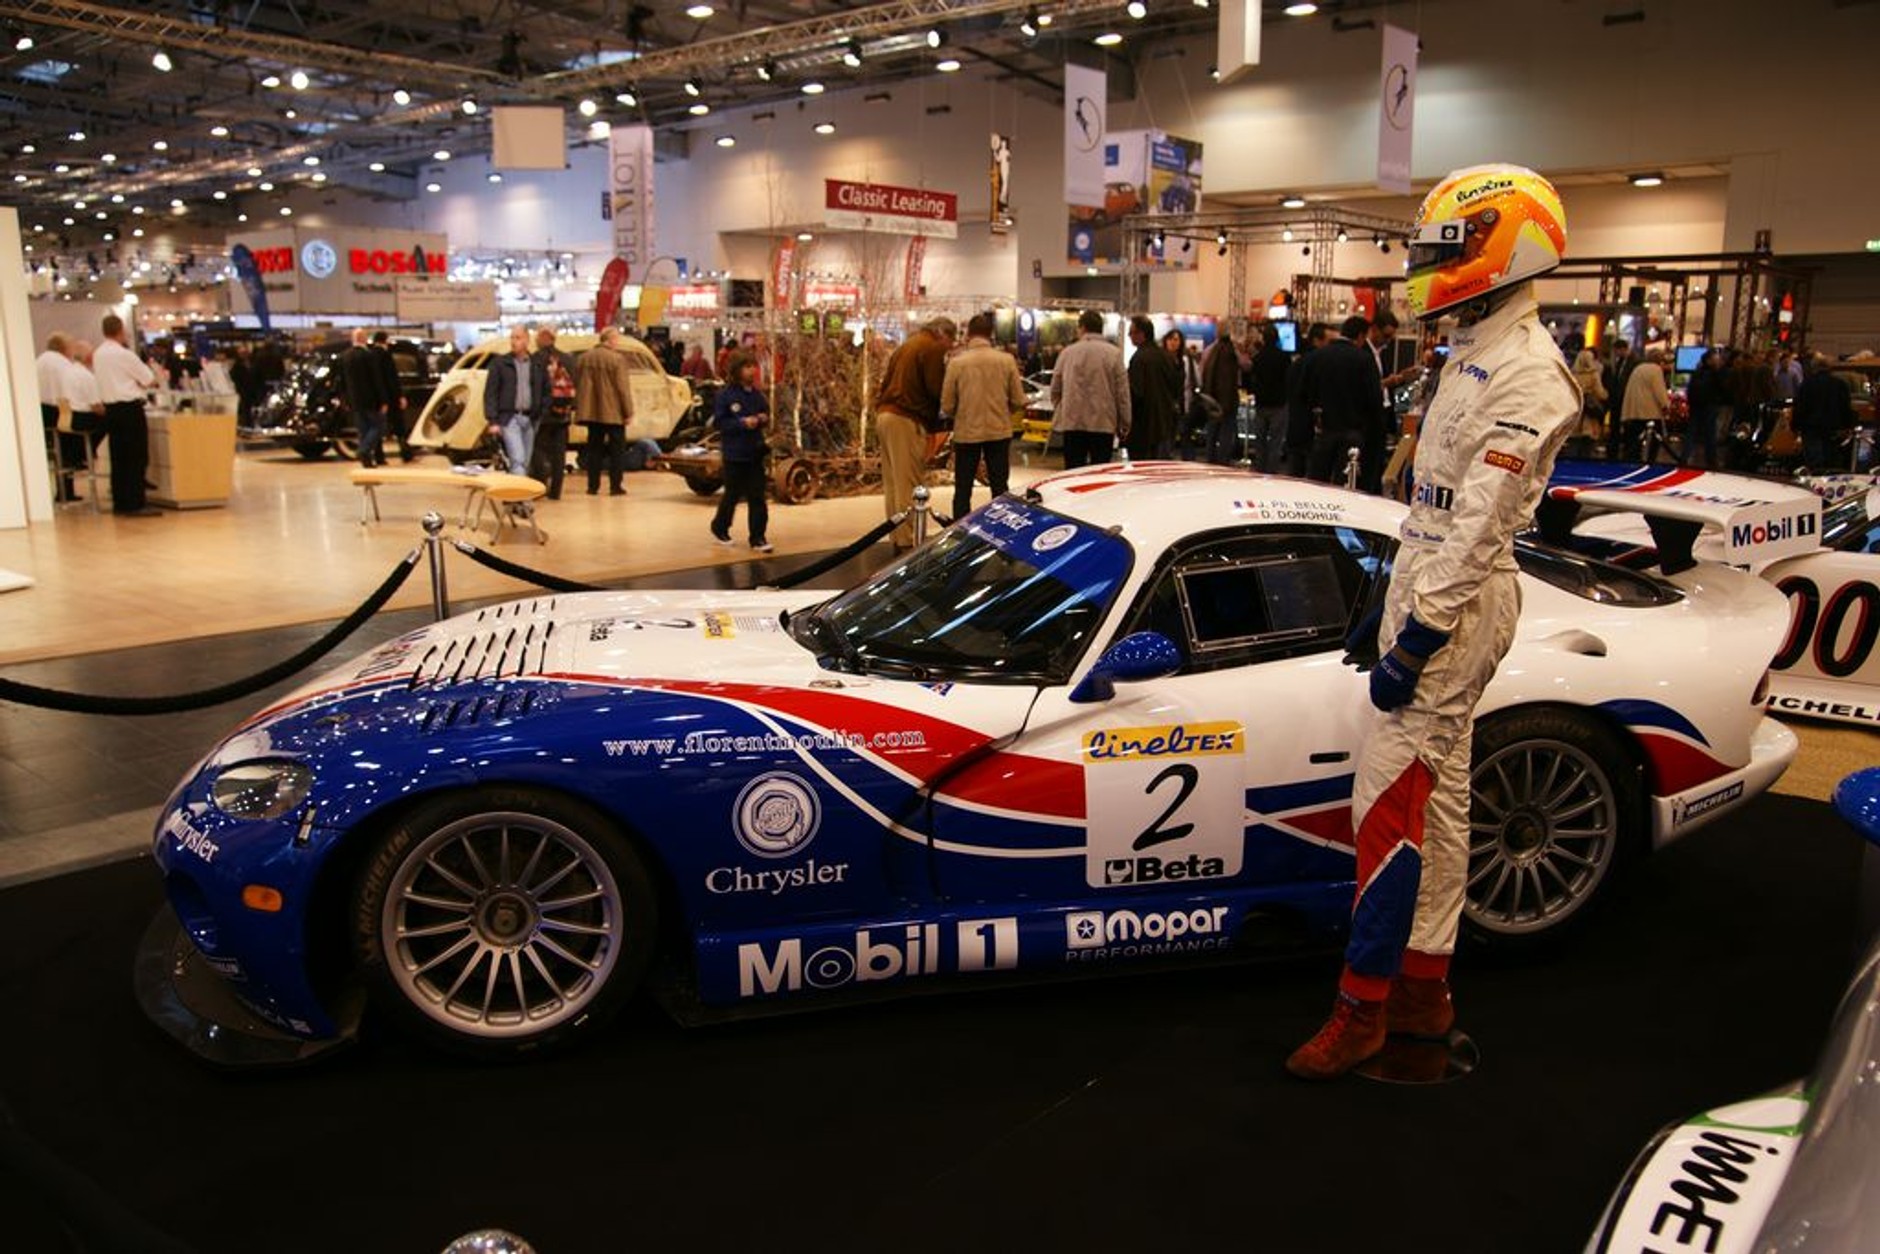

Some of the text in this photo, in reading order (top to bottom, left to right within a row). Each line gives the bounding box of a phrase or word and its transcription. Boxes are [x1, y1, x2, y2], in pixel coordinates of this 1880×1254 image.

[838, 184, 946, 219] Classic Leasing
[1278, 510, 1341, 520] DONOHUE
[1732, 516, 1792, 547] Mobil
[1767, 695, 1880, 722] ICHEL
[603, 729, 926, 755] www.florentmoulin.com
[1132, 763, 1199, 852] 2
[1687, 784, 1742, 817] MICHELIN
[359, 828, 411, 928] MICHELIN
[704, 859, 849, 896] Chrysler
[1136, 855, 1225, 882] Beta
[738, 923, 939, 997] Mobil
[1066, 936, 1231, 963] PERFORMANCE
